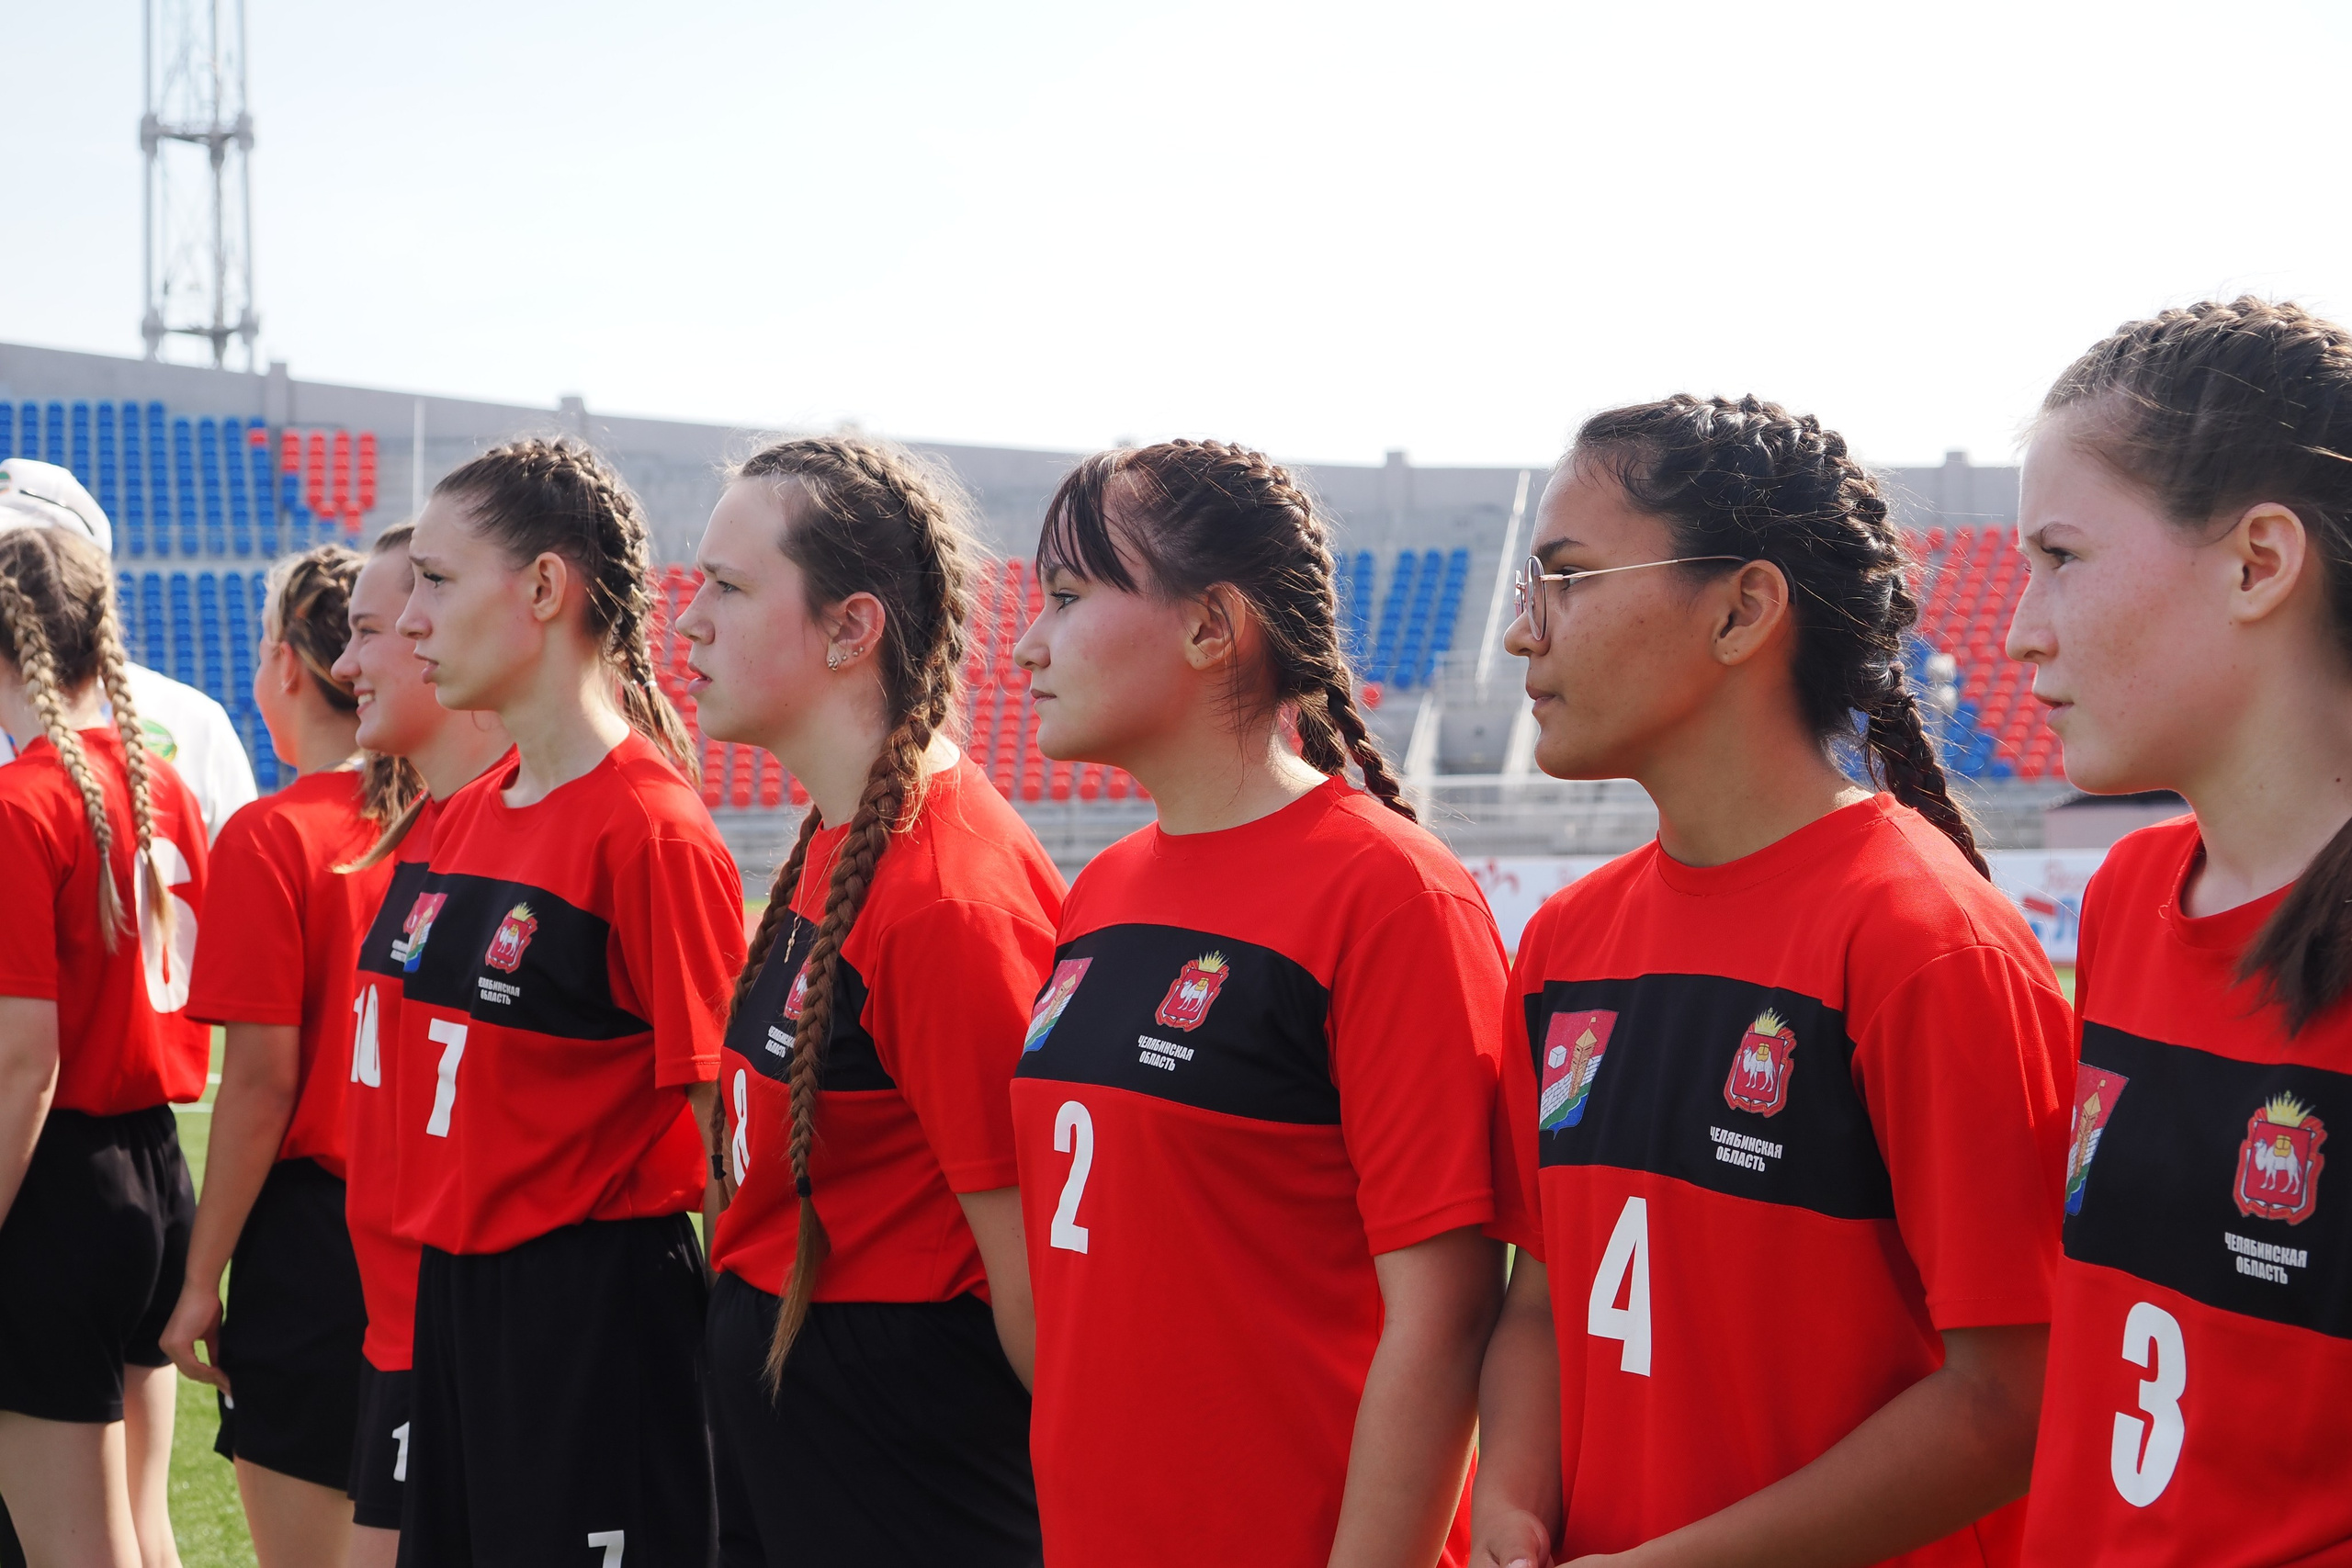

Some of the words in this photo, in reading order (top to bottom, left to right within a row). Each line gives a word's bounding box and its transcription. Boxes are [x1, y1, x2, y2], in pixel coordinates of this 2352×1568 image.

[350, 983, 381, 1089] 10
[1137, 1034, 1195, 1062] ЧЕЛЯБИНСКАЯ
[425, 1017, 469, 1138] 7
[1138, 1050, 1176, 1072] ОБЛАСТЬ
[1710, 1125, 1783, 1159] ЧЕЛЯБИНСКАЯ
[1715, 1145, 1766, 1172] ОБЛАСТЬ
[1050, 1100, 1094, 1255] 2
[2224, 1231, 2308, 1269] ЧЕЛЯБИНСКАЯ
[1587, 1195, 1652, 1378] 4
[2235, 1255, 2289, 1285] ОБЛАСТЬ
[2110, 1302, 2187, 1508] 3
[587, 1529, 625, 1568] 7
